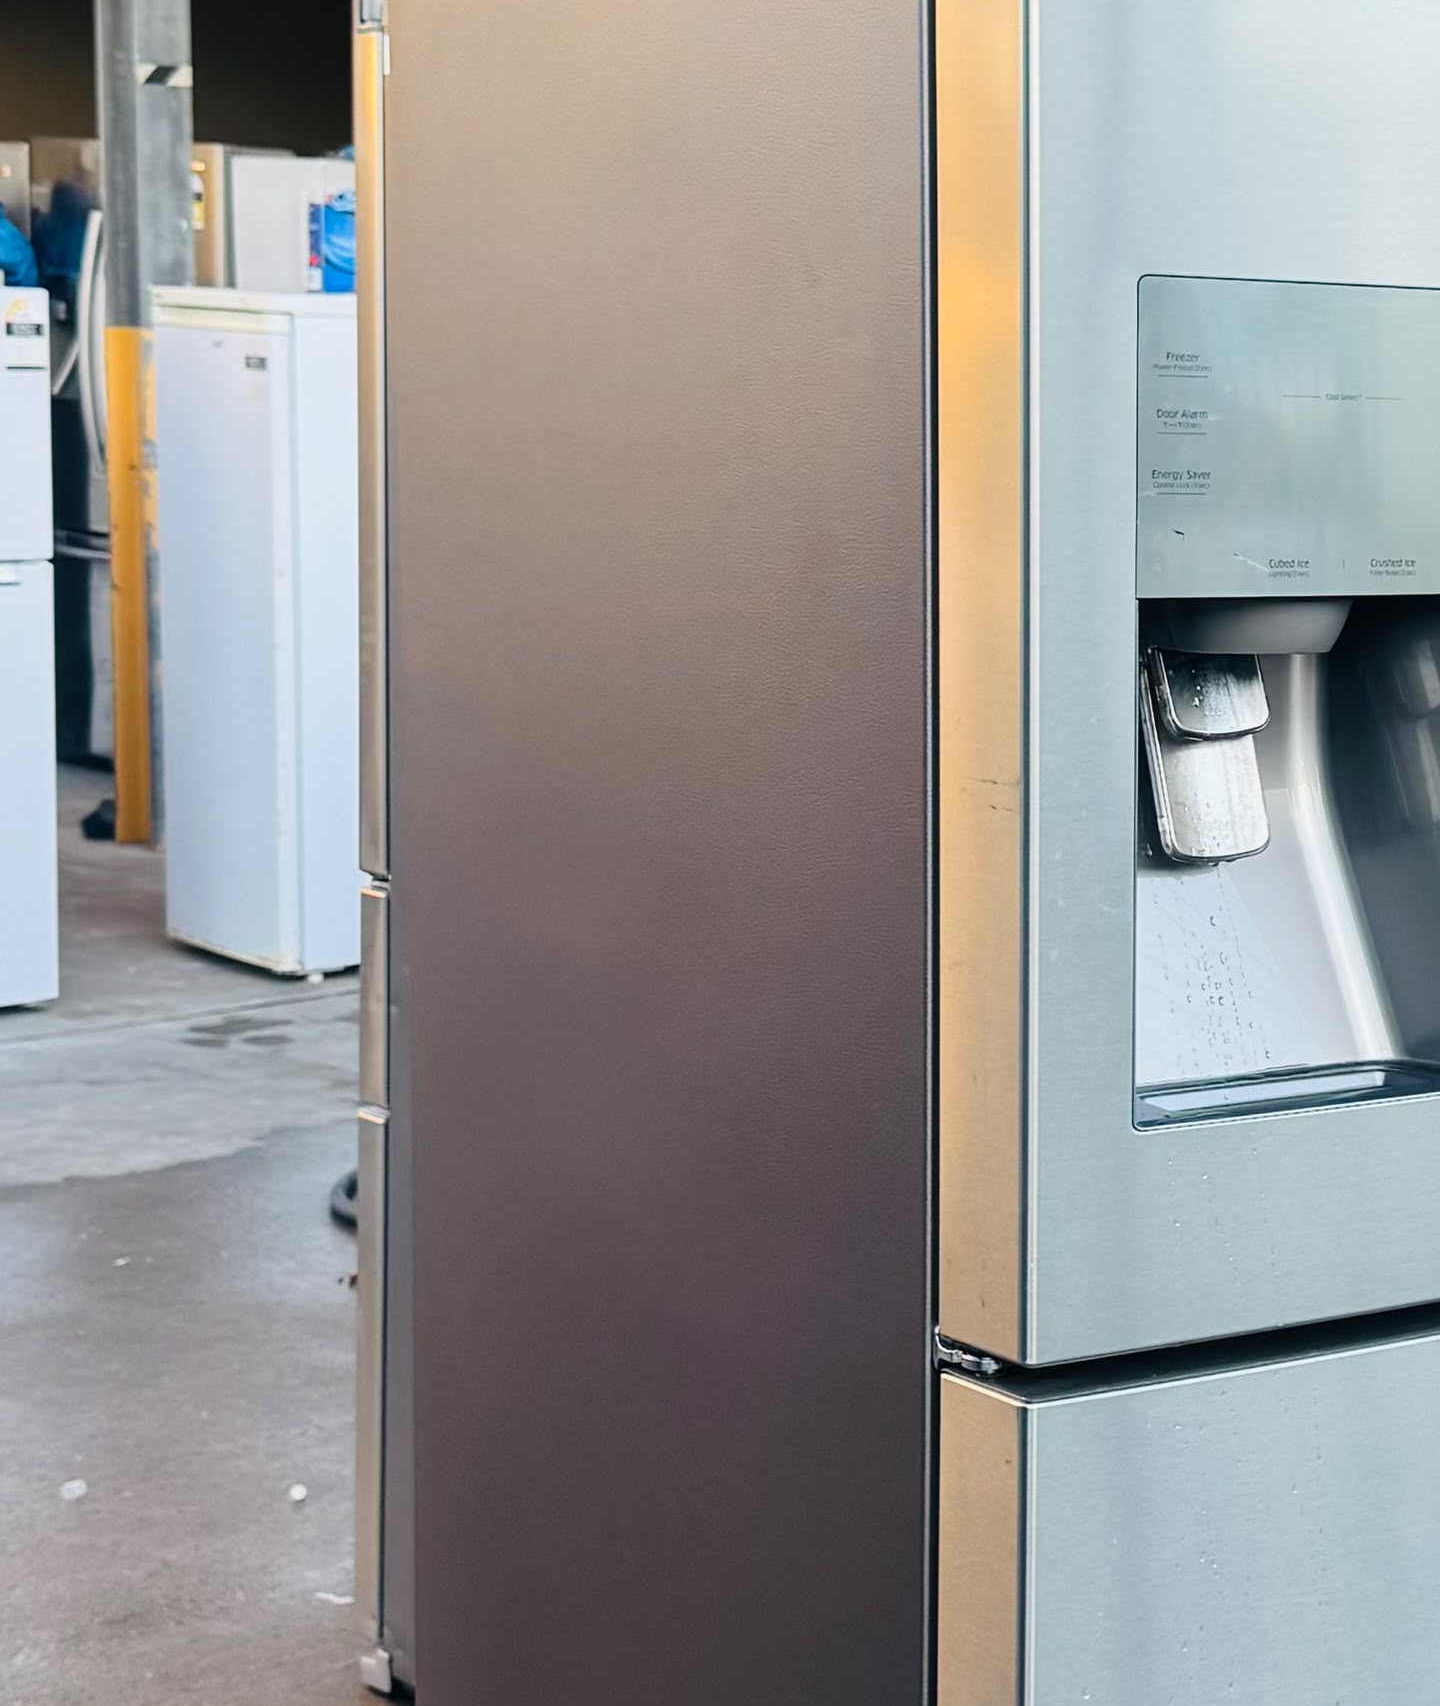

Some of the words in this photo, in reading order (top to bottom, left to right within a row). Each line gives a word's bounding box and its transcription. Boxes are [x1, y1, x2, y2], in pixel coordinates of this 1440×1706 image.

[1166, 351, 1200, 362] Freezer
[1156, 408, 1178, 419] Door
[1180, 408, 1208, 419] Alarm
[1152, 469, 1183, 481] Energy
[1186, 469, 1211, 480] Saver
[1268, 558, 1295, 569] Cubed
[1296, 559, 1310, 569] Ice
[1370, 558, 1403, 568] Crushed
[1404, 559, 1416, 568] Ice
